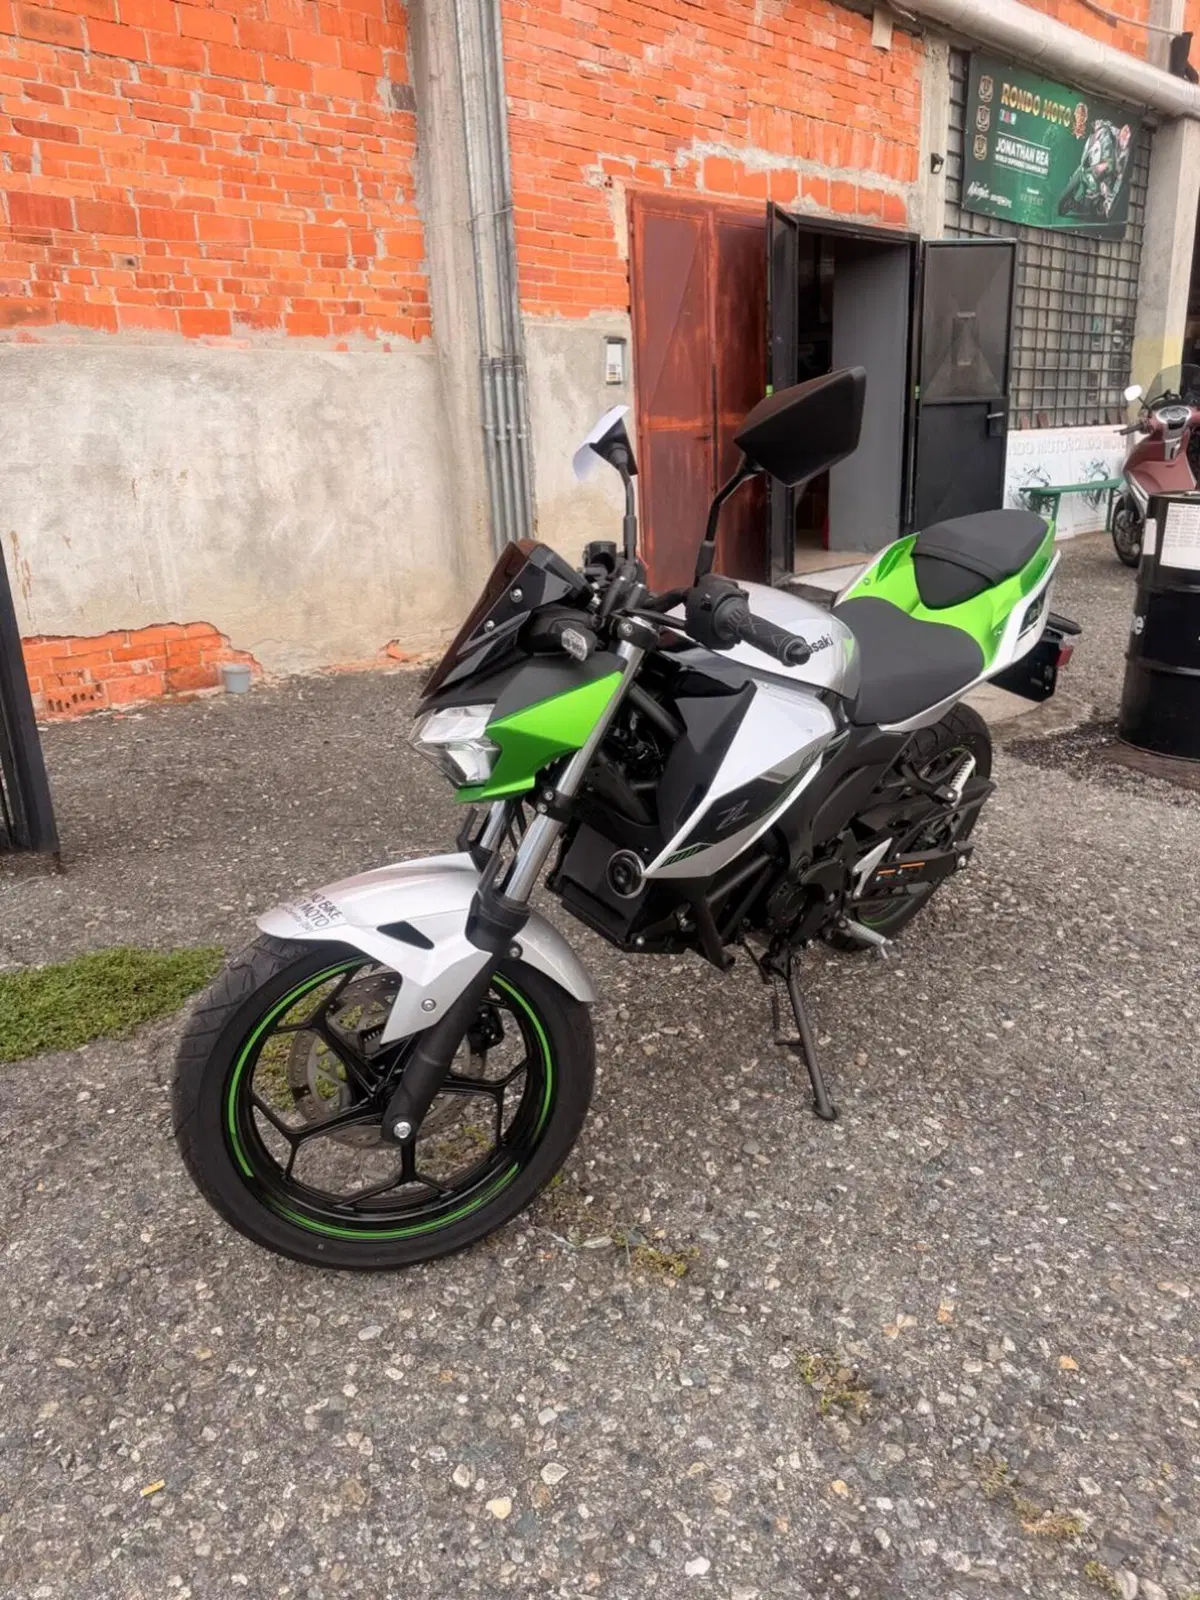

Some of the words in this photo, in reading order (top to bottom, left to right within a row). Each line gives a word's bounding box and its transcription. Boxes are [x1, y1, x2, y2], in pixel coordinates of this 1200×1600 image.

[1001, 83, 1041, 116] RONDO
[1042, 100, 1073, 127] MOTO
[995, 138, 1036, 163] JONATHAN
[806, 633, 834, 654] asaki
[299, 902, 330, 927] MOTO
[319, 901, 342, 920] BIKE
